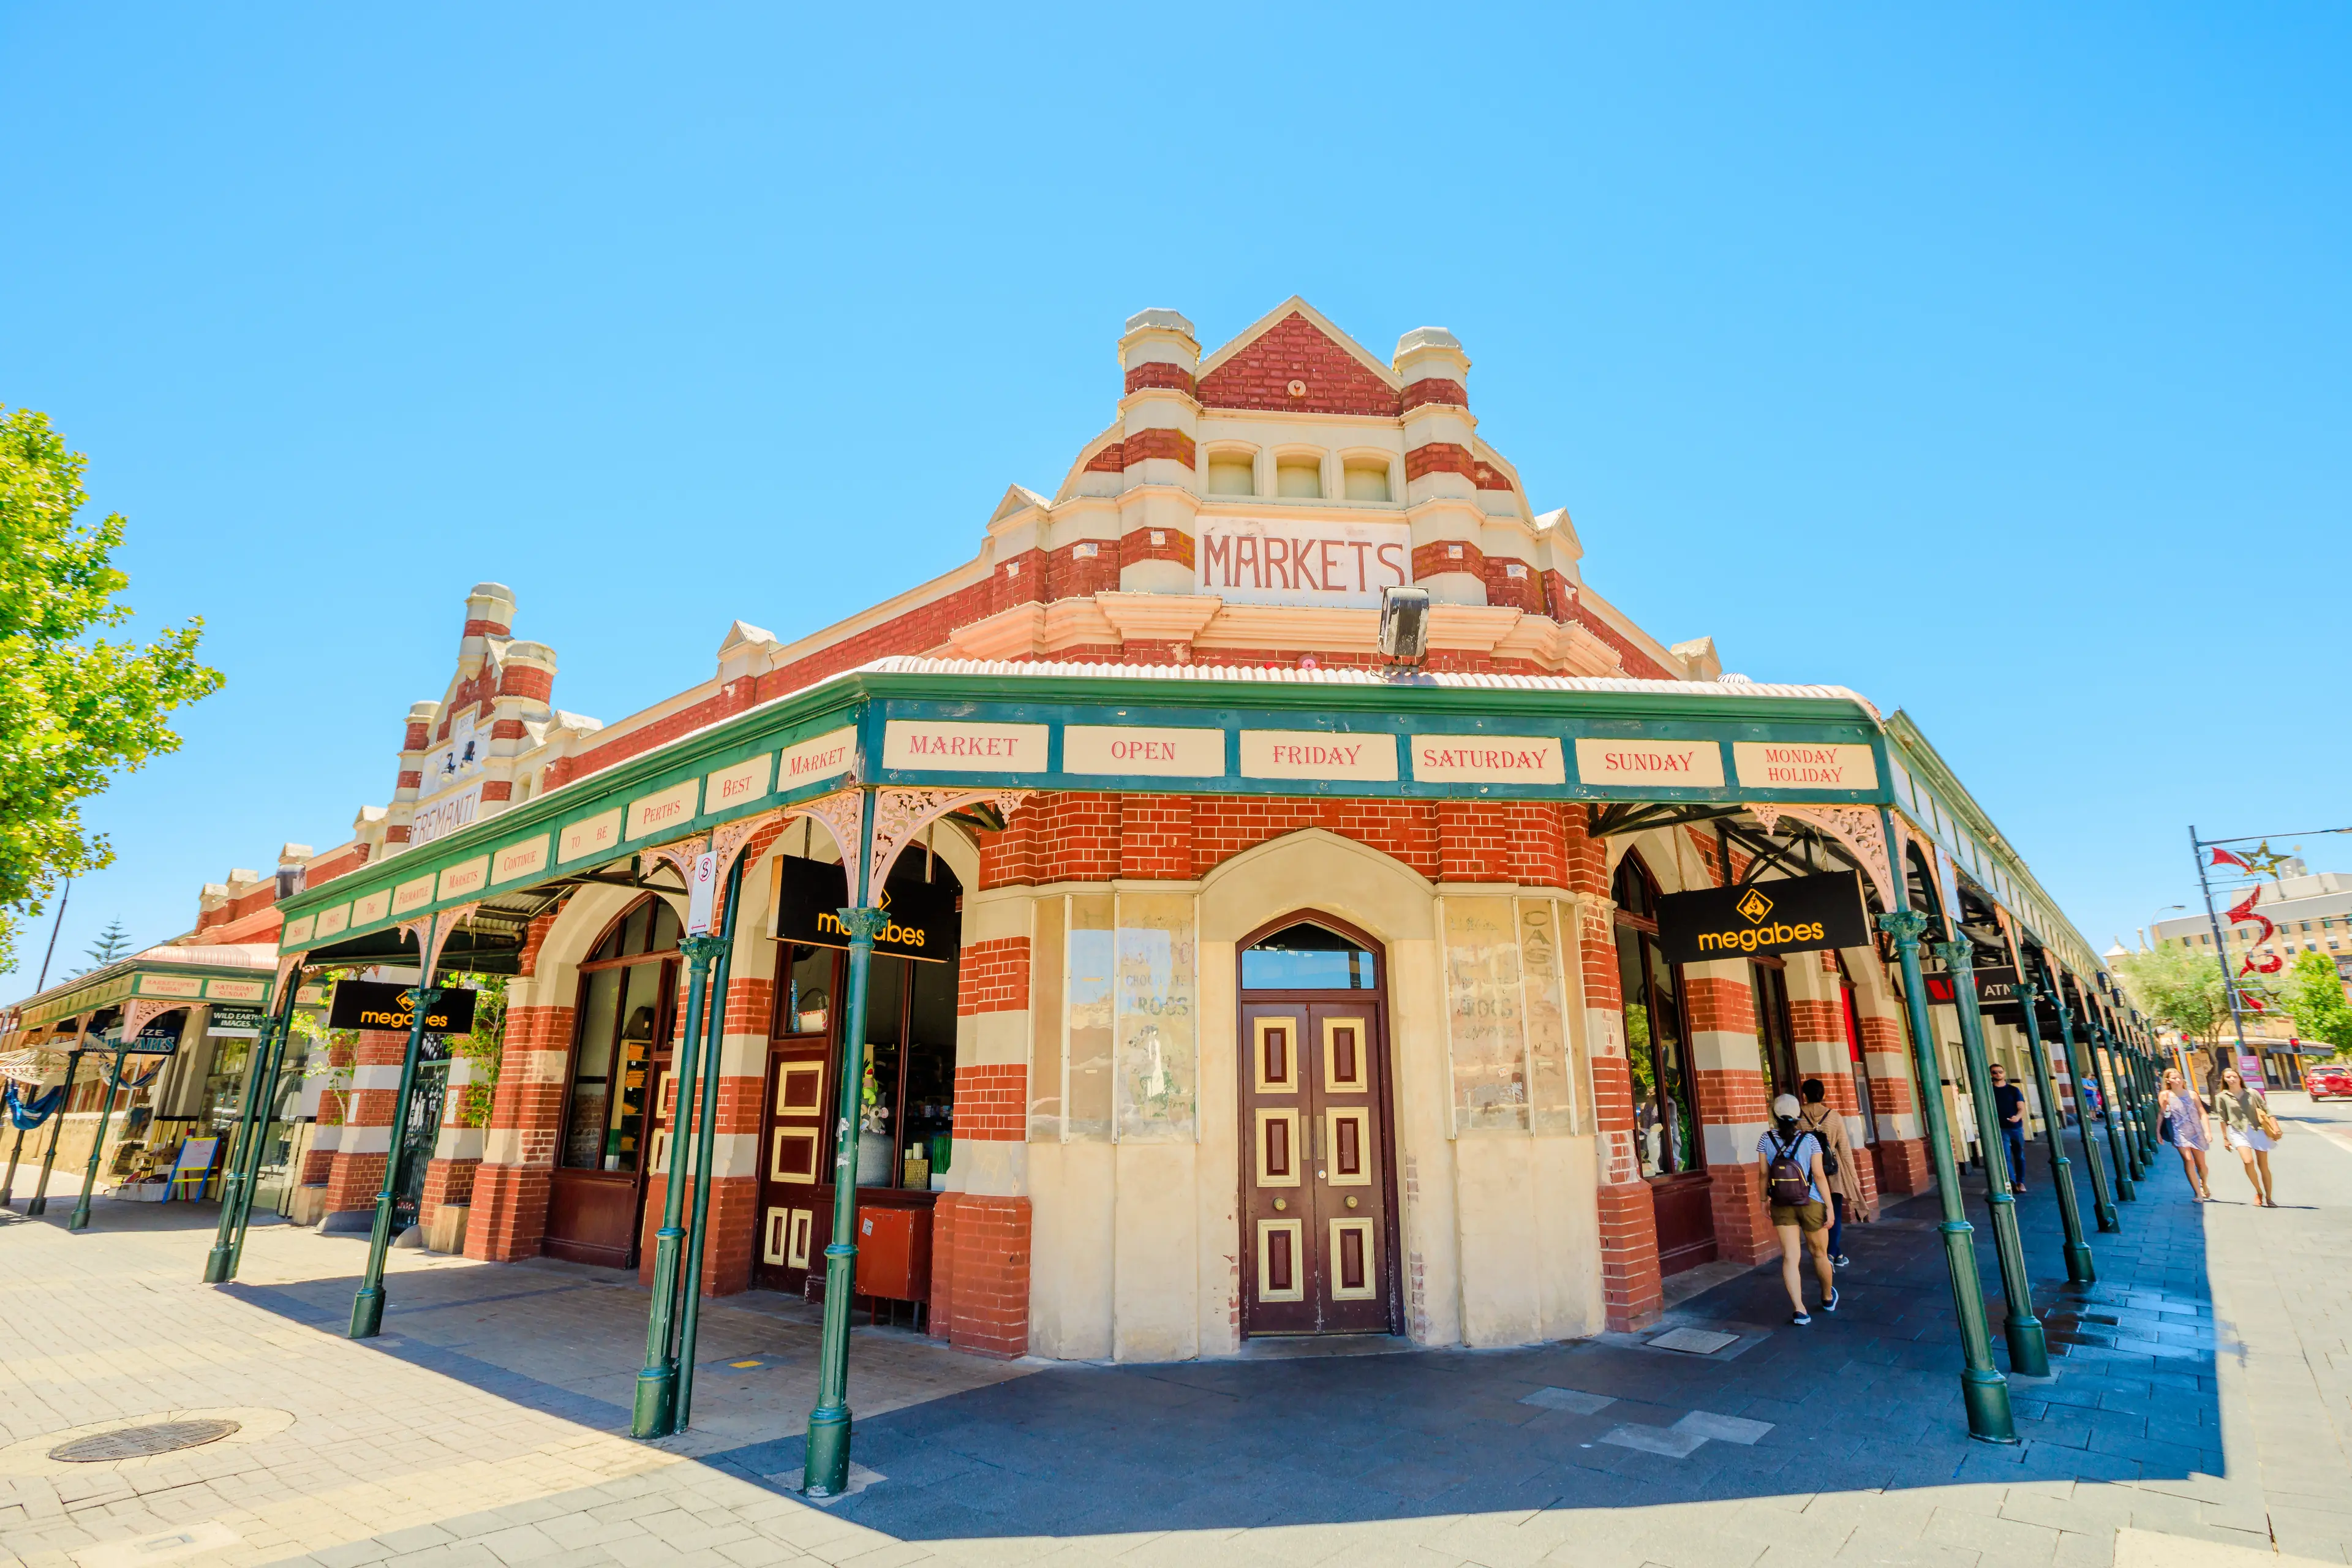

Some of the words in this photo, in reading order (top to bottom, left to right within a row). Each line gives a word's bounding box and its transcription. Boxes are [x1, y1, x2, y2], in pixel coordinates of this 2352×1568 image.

[1203, 534, 1405, 593] MARKETS
[909, 736, 1019, 757] MARKET
[1111, 741, 1176, 760] OPEN
[1273, 744, 1362, 766] FRIDAY
[1765, 748, 1838, 764] MONDAY
[789, 747, 845, 777] MARKET
[1423, 747, 1548, 769] SATURDAY
[1605, 752, 1694, 772] SUNDAY
[1768, 766, 1844, 783] HOLIDAY
[723, 775, 753, 797] BEST
[643, 800, 680, 824] PERTH'S
[571, 835, 581, 850] TO
[597, 826, 608, 840] BE
[503, 850, 537, 872] CONTINUE
[448, 871, 478, 889] MARKETS
[399, 886, 429, 905] FREMANTLE
[818, 912, 925, 947] mabes
[1698, 920, 1824, 952] megabes
[361, 1011, 448, 1028] megaes
